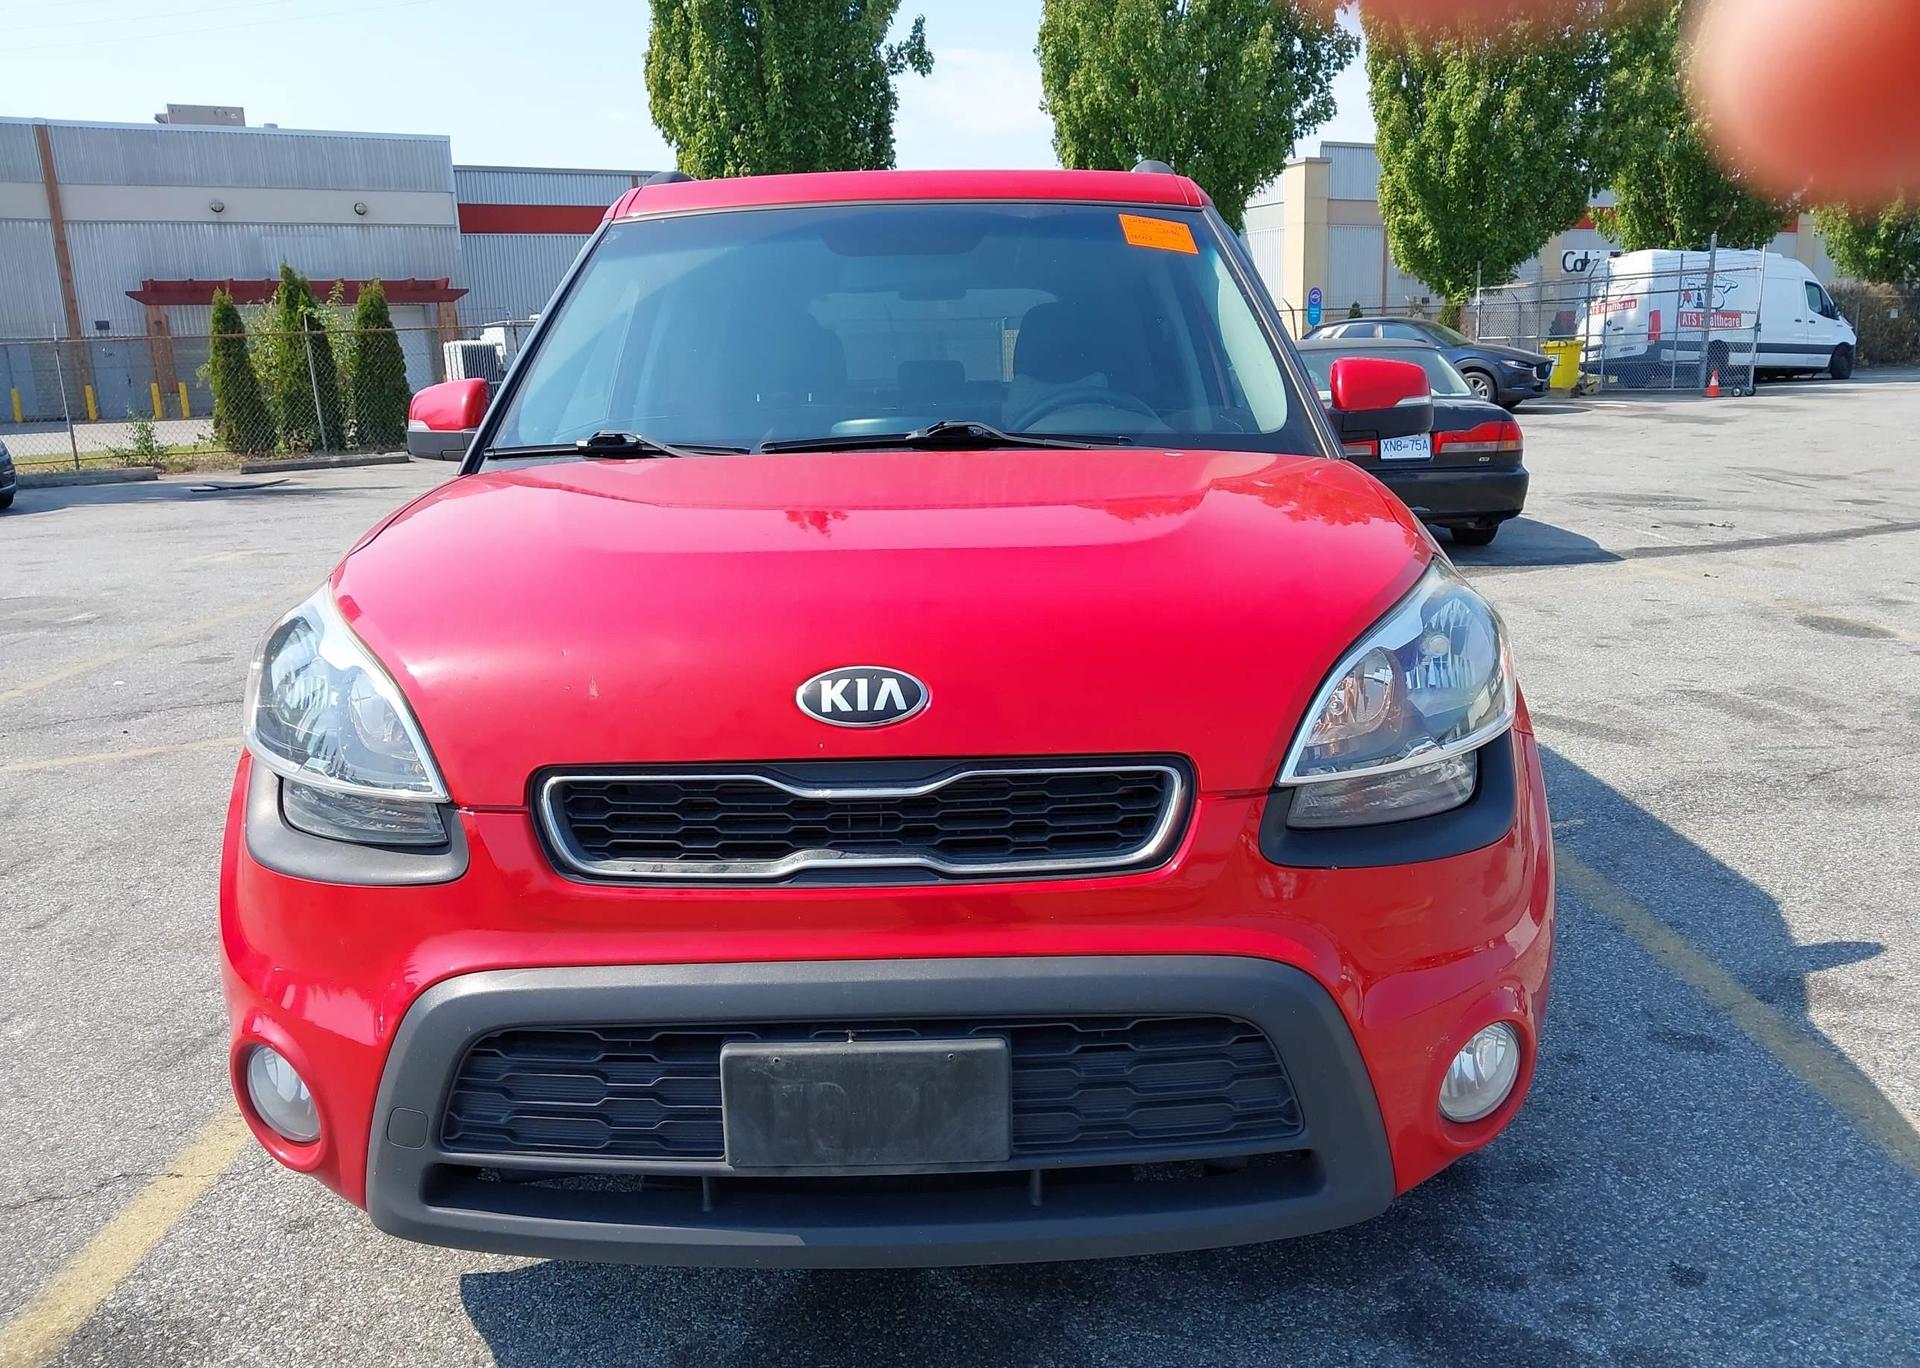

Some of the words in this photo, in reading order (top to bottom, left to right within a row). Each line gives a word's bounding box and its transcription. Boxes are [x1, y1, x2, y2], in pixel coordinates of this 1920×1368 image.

[1600, 301, 1636, 313] Halthcare
[1682, 313, 1697, 326] ATS
[1700, 314, 1739, 327] Halthcare
[819, 677, 907, 713] KIA
